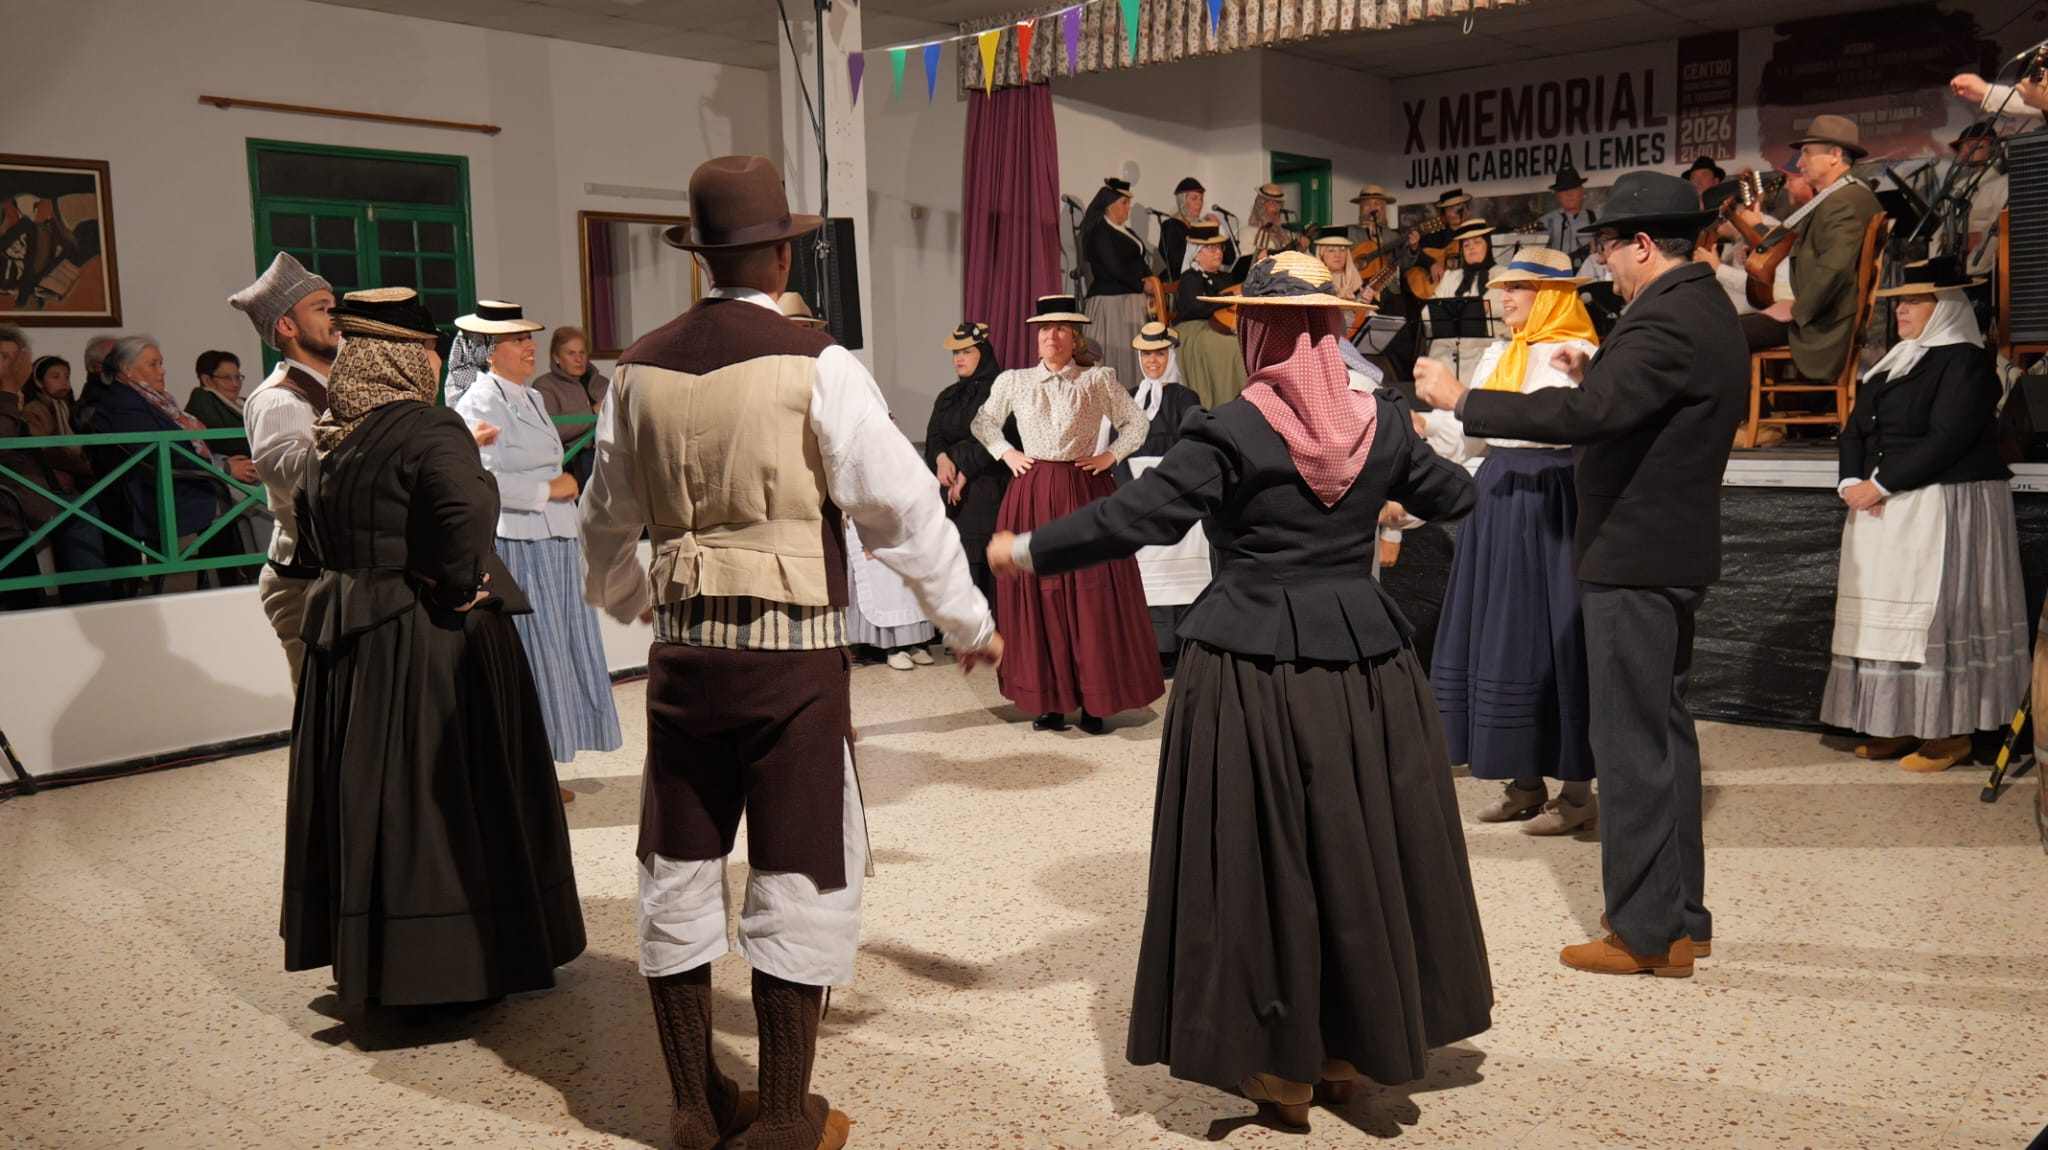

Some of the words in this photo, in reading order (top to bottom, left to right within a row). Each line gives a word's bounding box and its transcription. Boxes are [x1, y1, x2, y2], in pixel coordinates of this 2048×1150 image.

[1684, 60, 1732, 80] CENTRO
[1403, 99, 1426, 154] X
[1439, 69, 1668, 149] MEMORIAL
[1681, 115, 1730, 144] 2026
[1406, 154, 1458, 189] JUAN
[1467, 143, 1574, 181] CABRERA
[1584, 132, 1665, 171] LEMES
